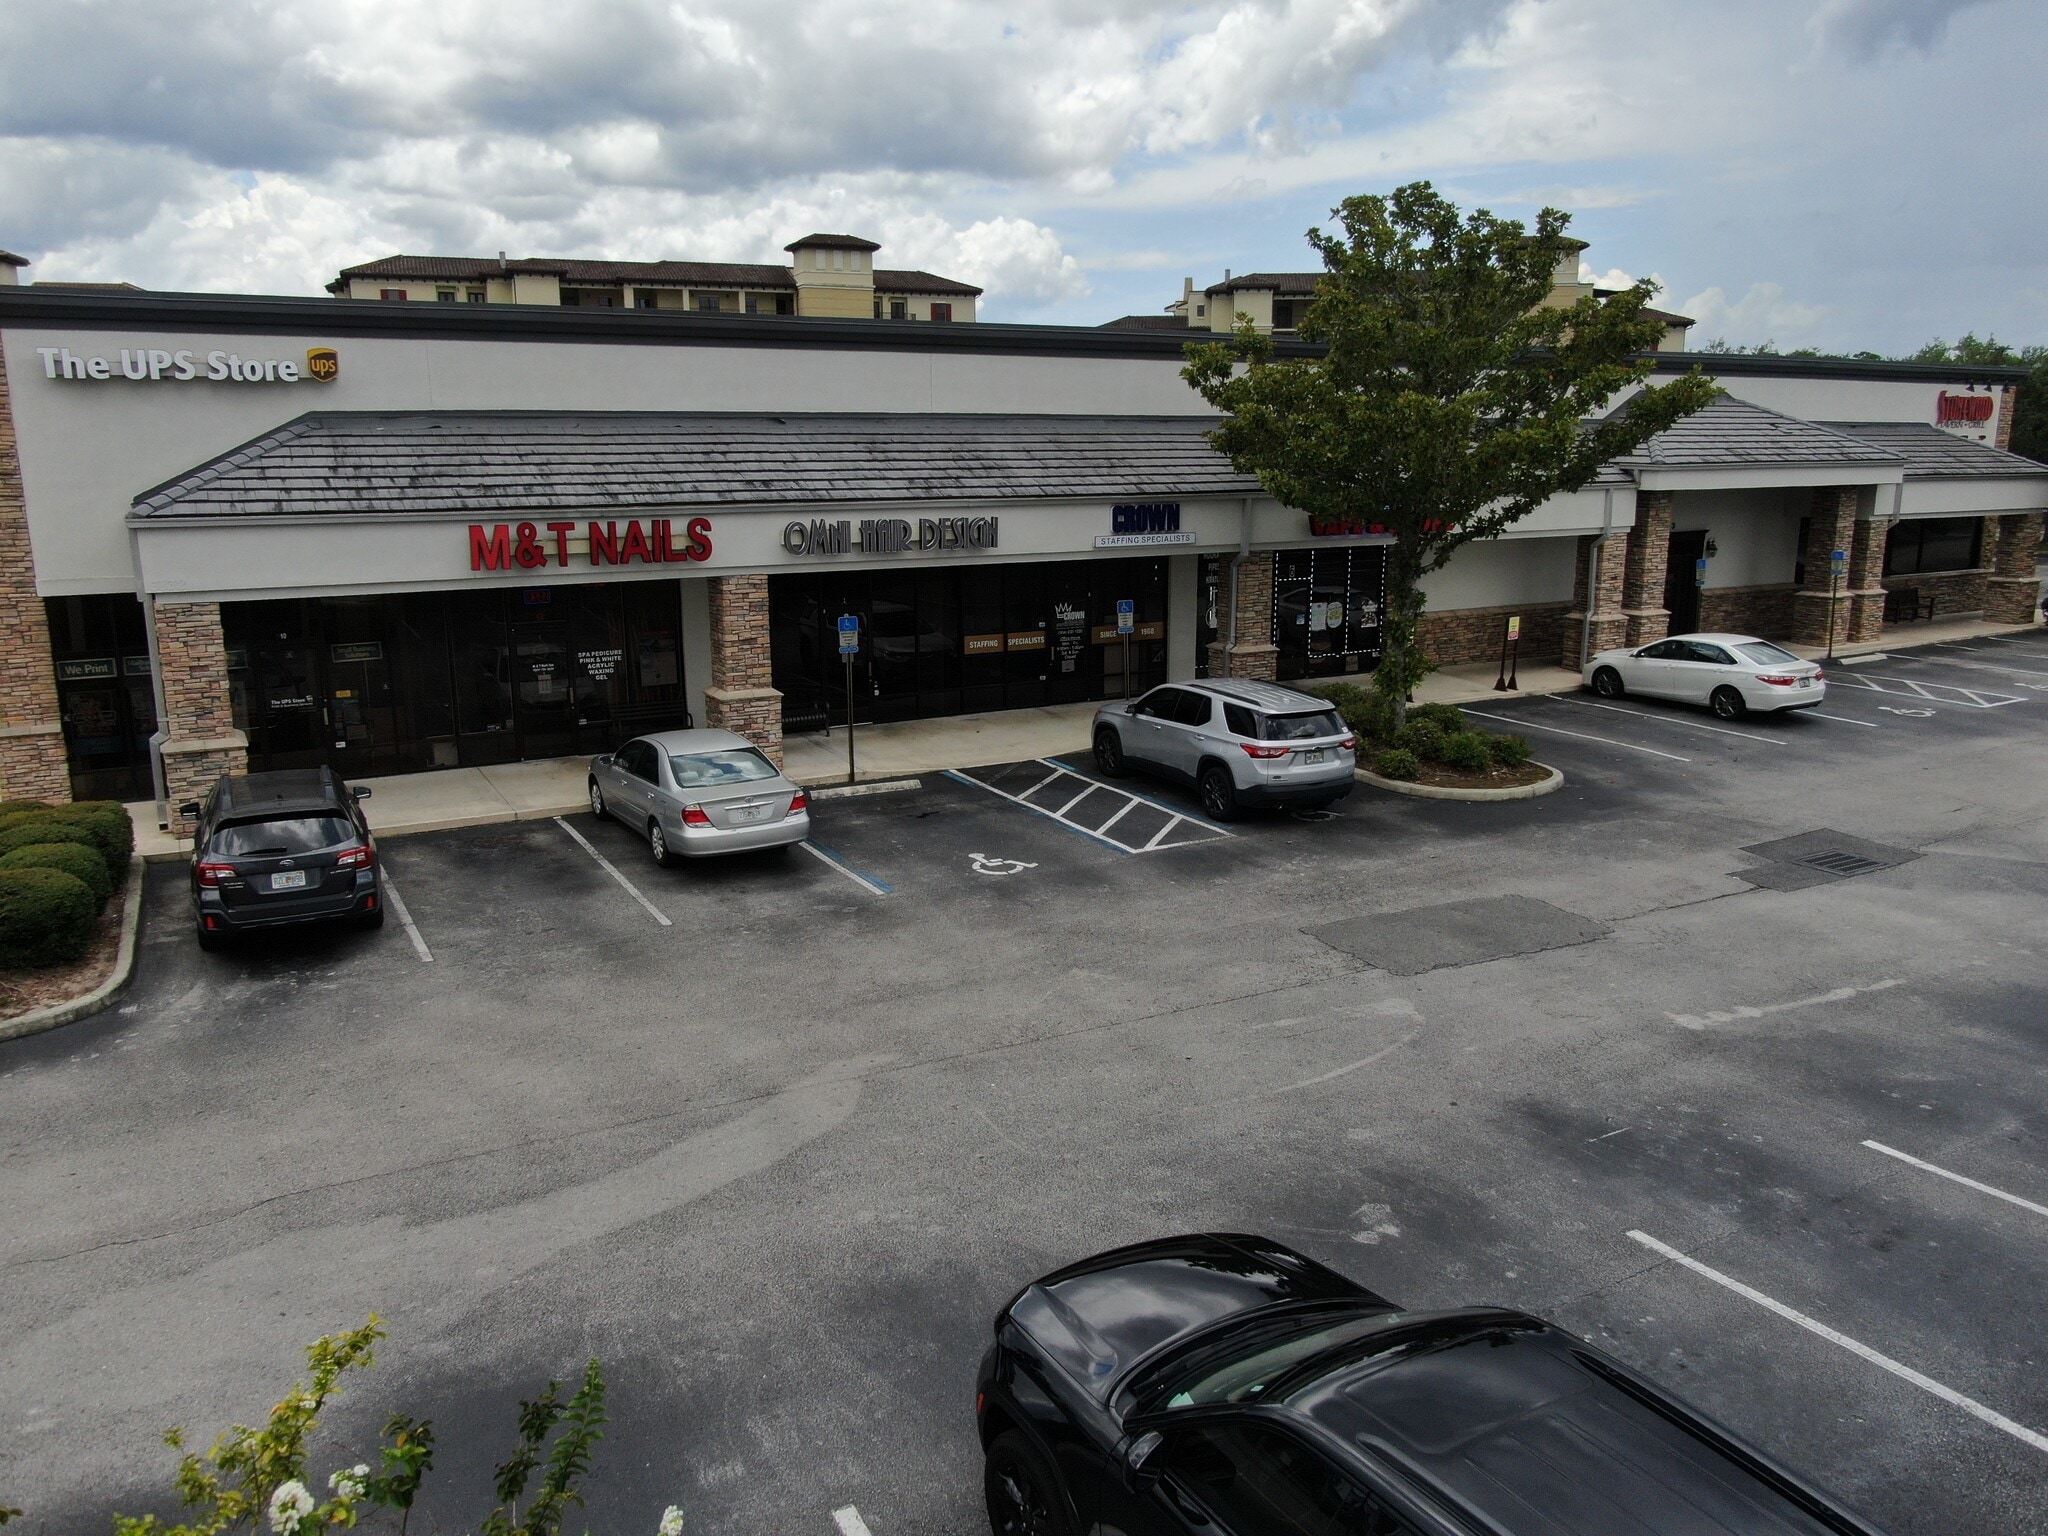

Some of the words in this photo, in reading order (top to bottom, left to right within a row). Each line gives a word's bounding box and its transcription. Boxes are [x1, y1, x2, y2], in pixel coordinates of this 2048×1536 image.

[37, 347, 110, 380] The
[120, 349, 197, 380] UPS
[207, 350, 299, 382] Store
[311, 358, 336, 373] ups
[1111, 504, 1180, 533] CROWN
[784, 518, 851, 556] OMNI
[859, 518, 914, 553] HAIR
[918, 516, 999, 550] DESIGN
[1101, 536, 1139, 545] STAFFING
[1141, 534, 1190, 544] SPECIALISTS
[468, 521, 575, 571] M&T
[588, 517, 713, 566] NAILS
[1064, 611, 1085, 620] CROWN
[969, 640, 998, 649] STAFFING
[1008, 636, 1045, 646] SPECIALISTS
[65, 665, 82, 674] We
[84, 664, 108, 674] Print
